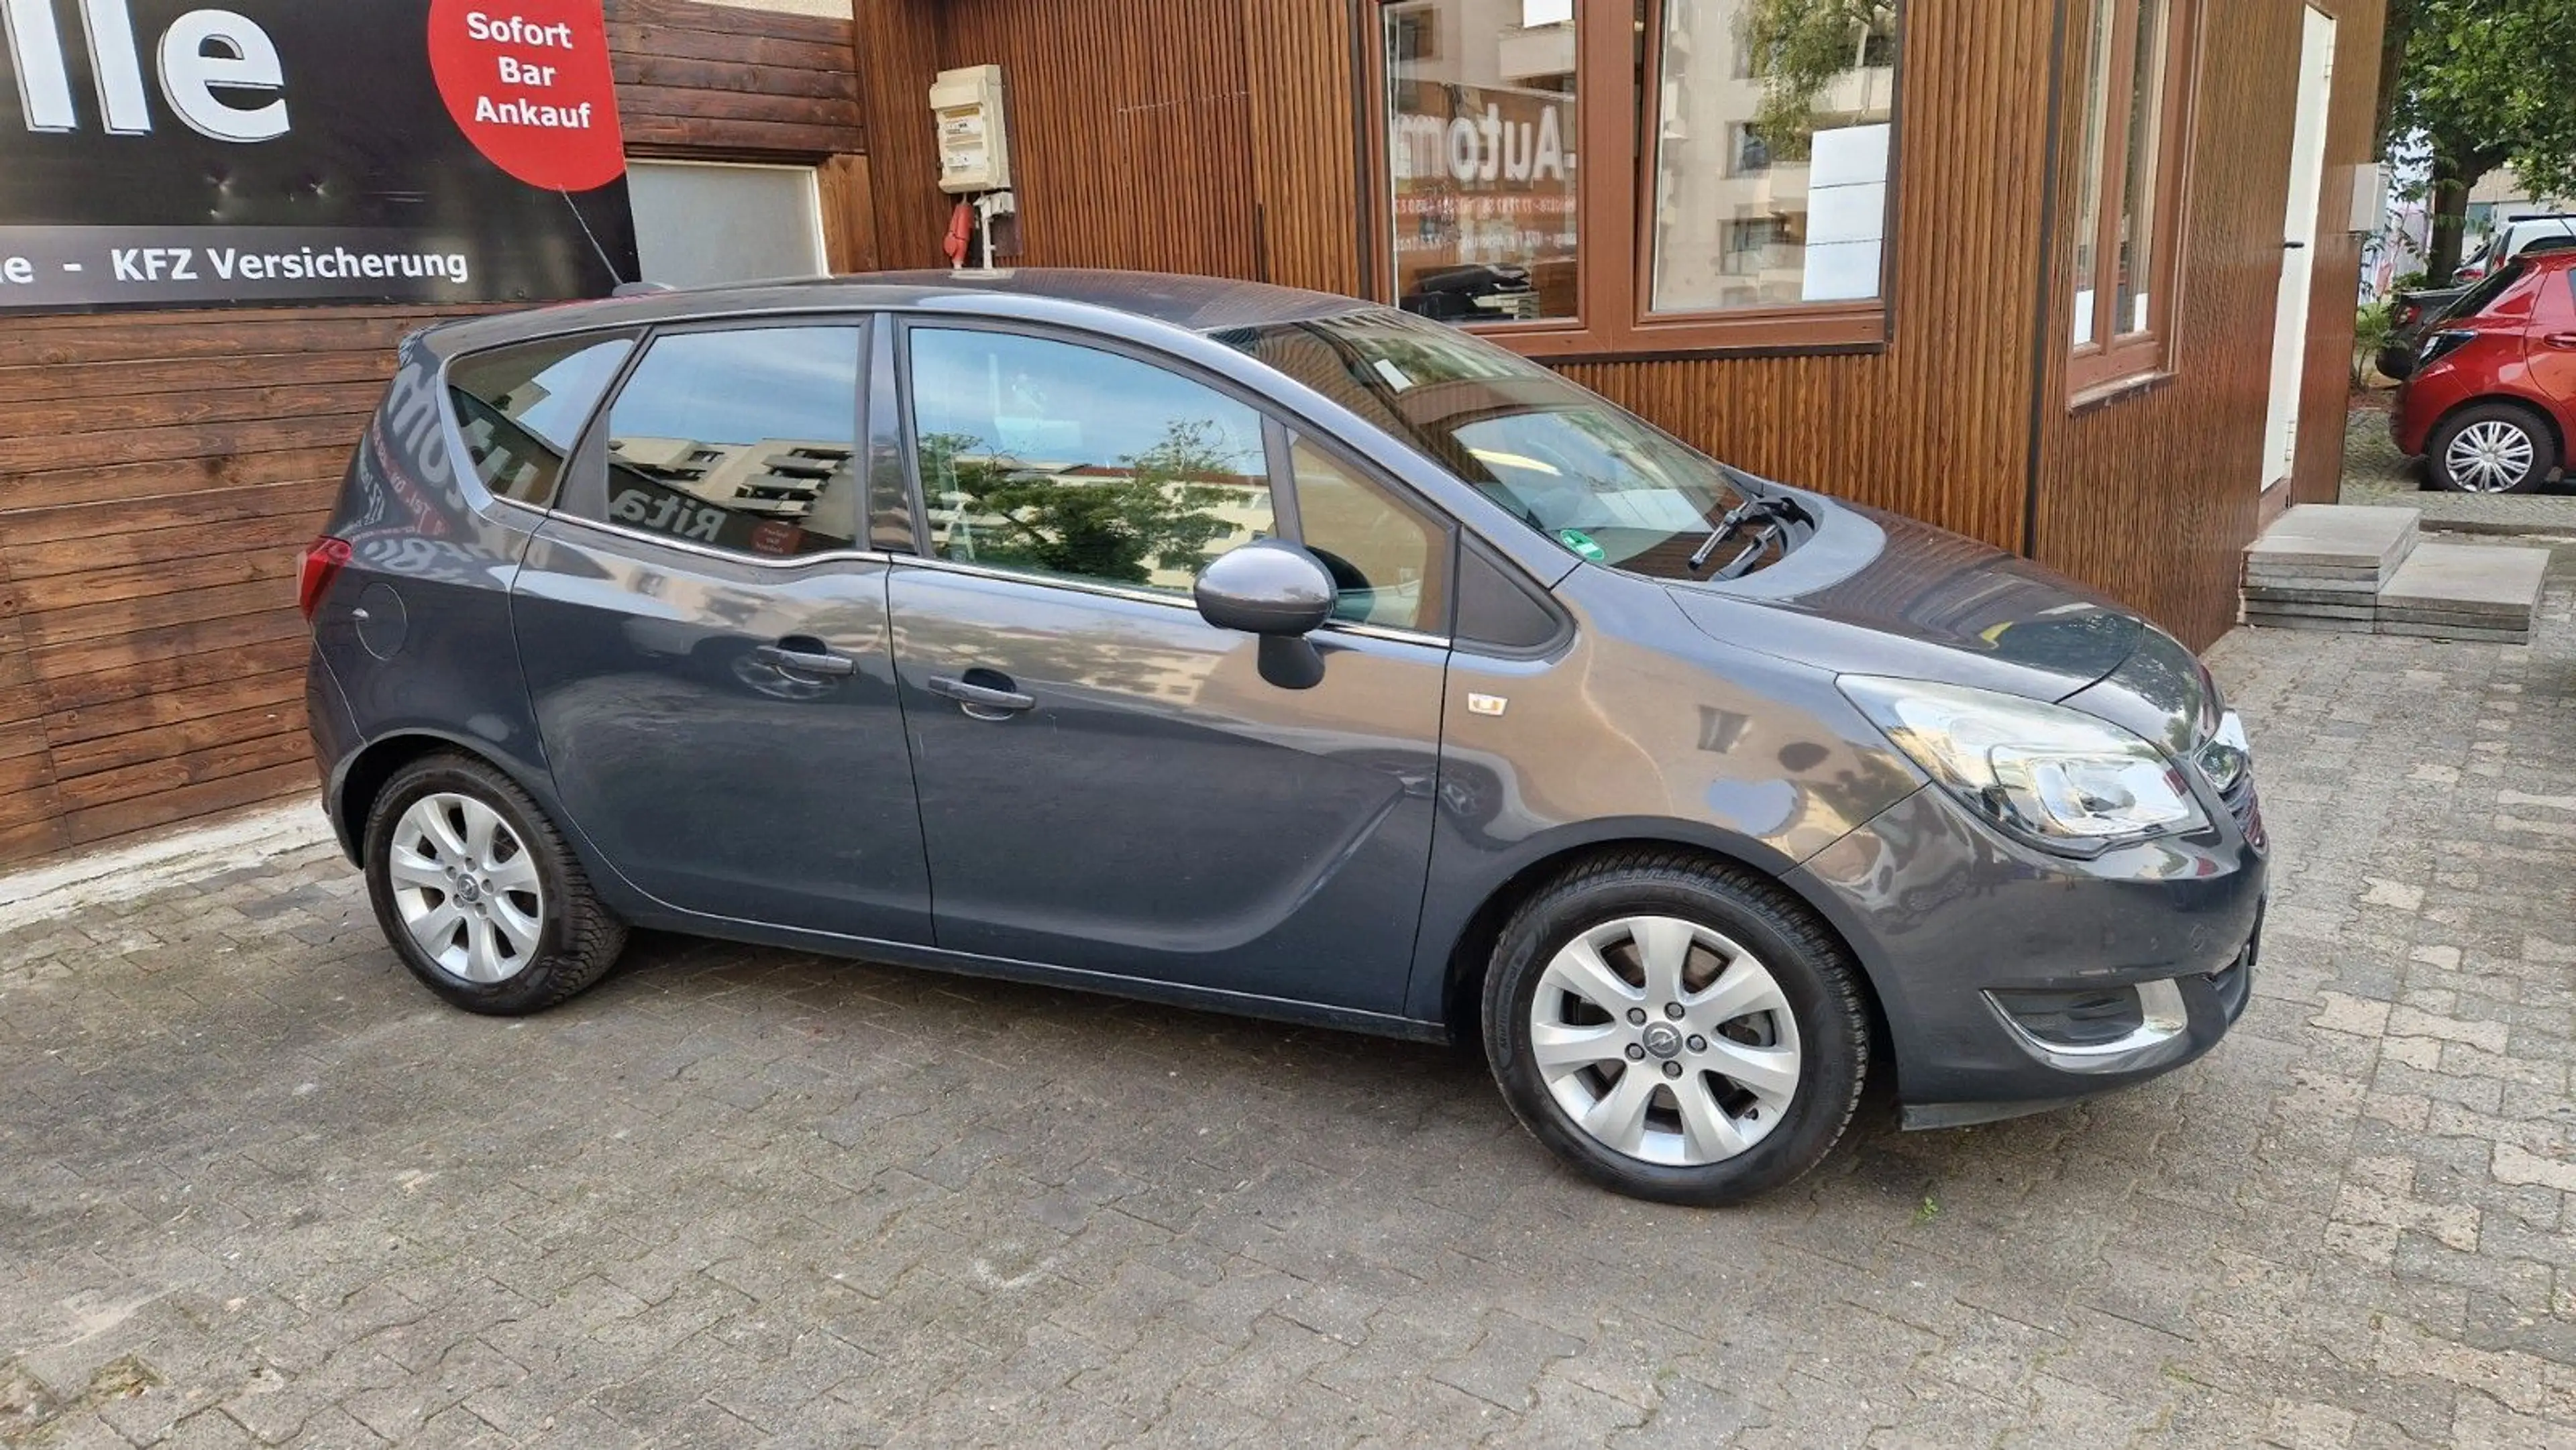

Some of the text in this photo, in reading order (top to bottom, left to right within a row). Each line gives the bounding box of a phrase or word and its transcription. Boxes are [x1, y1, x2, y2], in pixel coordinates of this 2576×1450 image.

[467, 12, 574, 50] Sofort
[497, 56, 556, 87] Bar
[474, 97, 591, 129] Ankauf
[0, 256, 34, 284] e
[111, 247, 198, 282] KFZ
[207, 246, 468, 282] Versicherung
